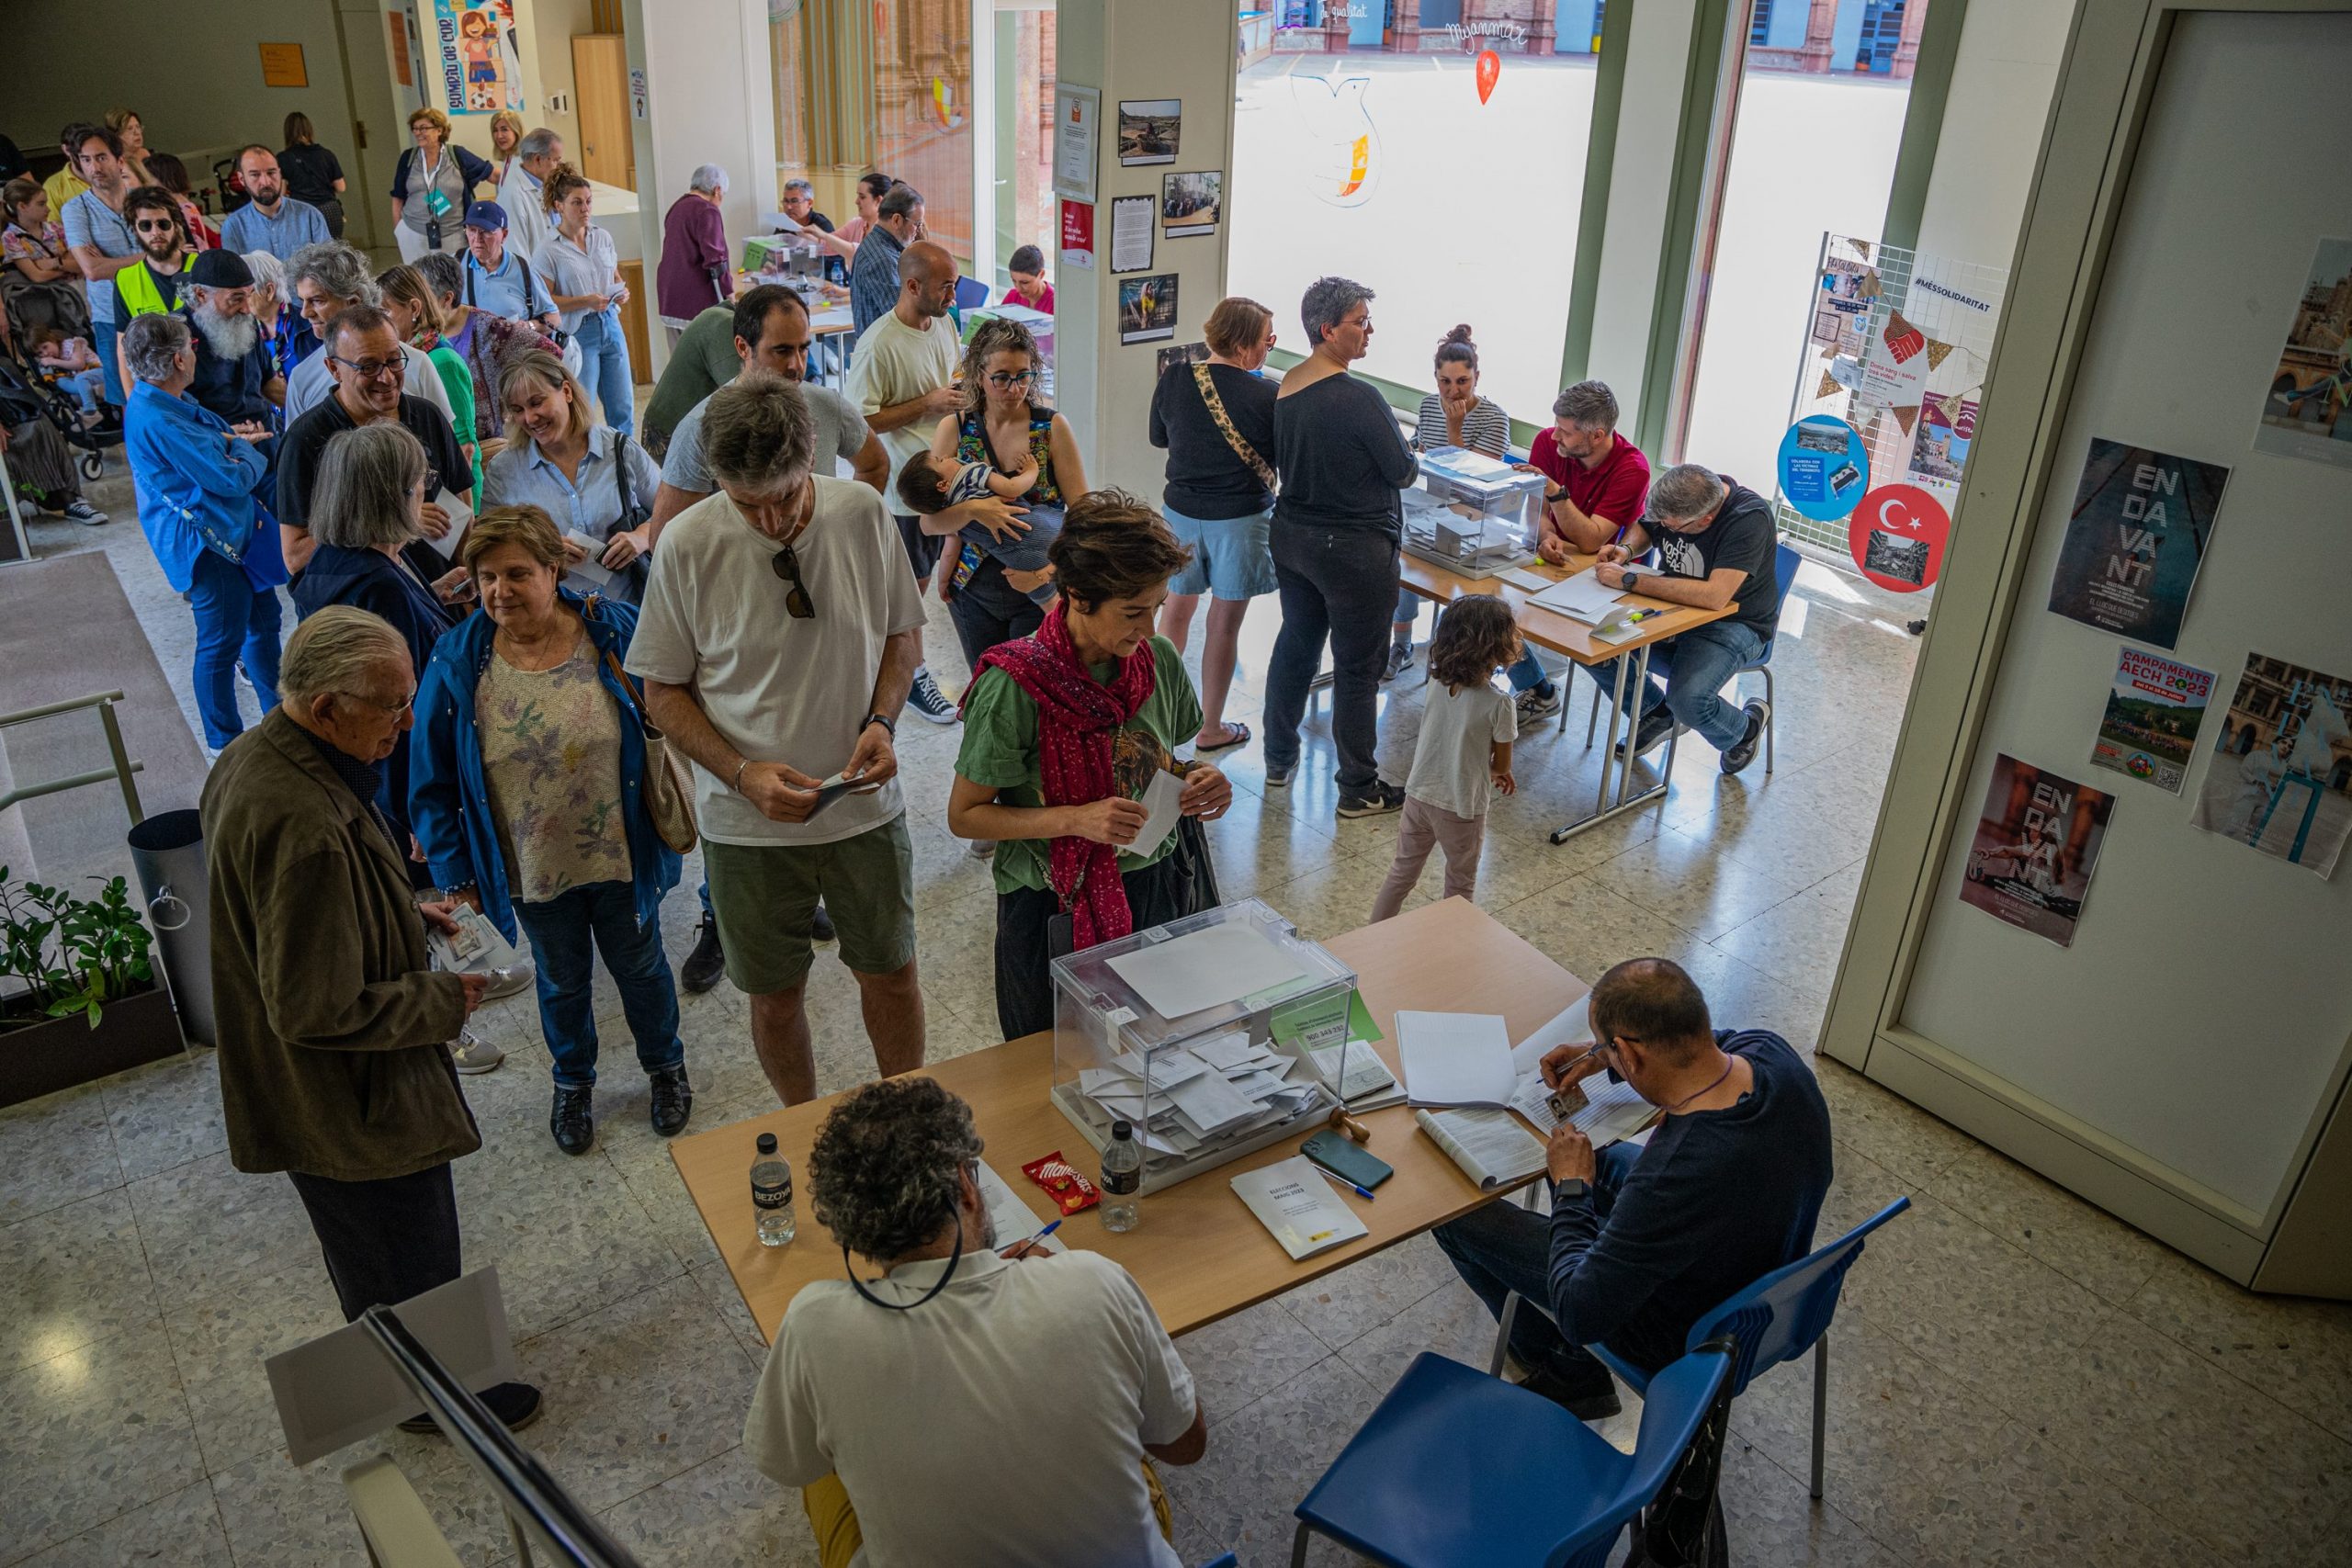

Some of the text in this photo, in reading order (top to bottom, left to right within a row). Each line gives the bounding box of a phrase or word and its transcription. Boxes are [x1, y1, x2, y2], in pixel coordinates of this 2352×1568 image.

[1331, 3, 1368, 24] qualitat
[1445, 21, 1529, 55] Myanmar
[1064, 225, 1082, 235] Escola
[1915, 277, 1991, 313] #MÉSSOLIDARITAT
[1868, 367, 1880, 376] tres
[1870, 361, 1884, 371] Dona
[1884, 367, 1898, 377] sang
[1902, 372, 1917, 381] salva
[2132, 464, 2179, 496] EN
[2121, 493, 2167, 528] DA
[2120, 524, 2156, 558] VA
[2106, 554, 2152, 587] NT
[2120, 660, 2163, 683] AECH
[2123, 651, 2211, 685] CAMPAMENTS
[2032, 781, 2073, 815] EN
[2023, 807, 2064, 841] DA
[2021, 831, 2053, 866] VA
[2008, 858, 2050, 889] NT
[1306, 1032, 1319, 1041] 900
[1319, 1029, 1332, 1037] 343
[754, 1186, 791, 1201] BEZOYA
[1269, 1182, 1299, 1195] ELECCIONS
